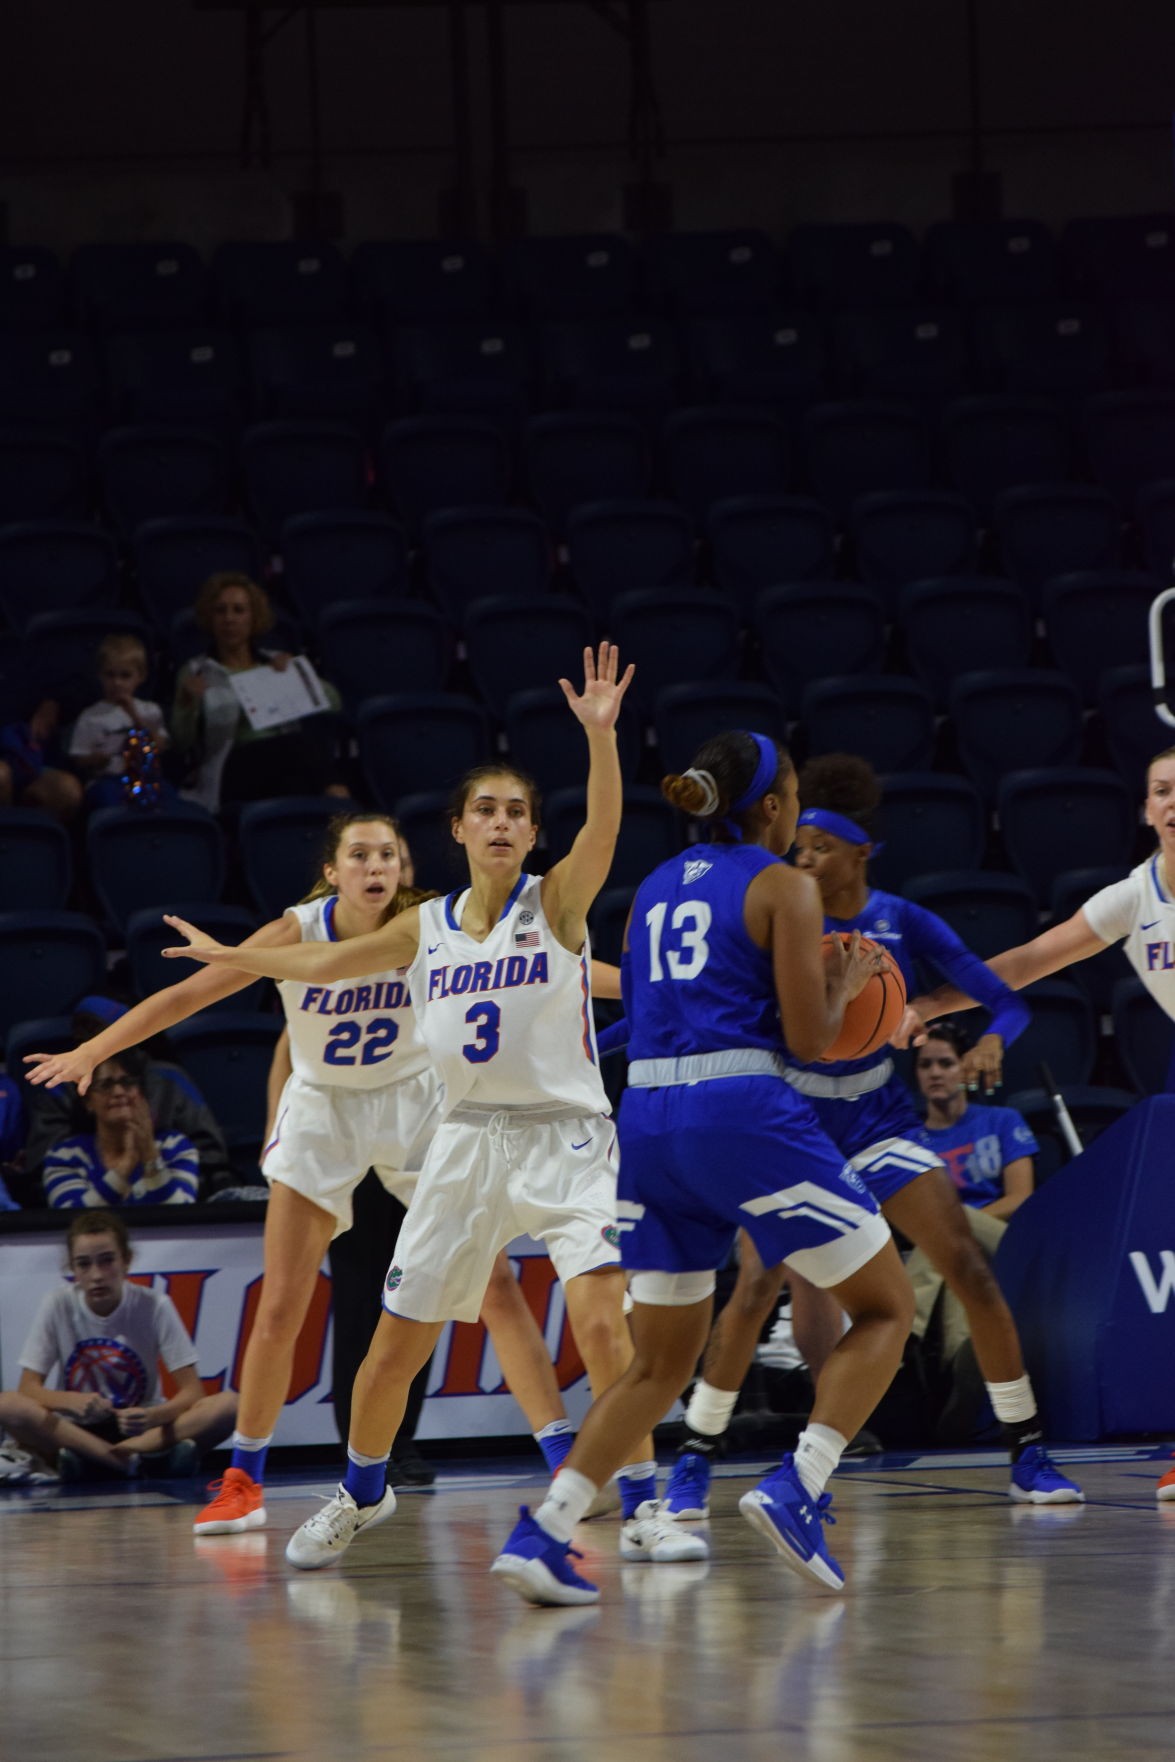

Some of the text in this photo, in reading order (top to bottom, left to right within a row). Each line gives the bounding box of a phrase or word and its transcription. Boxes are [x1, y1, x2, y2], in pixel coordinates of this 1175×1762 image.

[645, 899, 713, 983] 13
[428, 951, 548, 1002] FLORIDA
[324, 1017, 399, 1067] 22
[462, 1000, 501, 1064] 3
